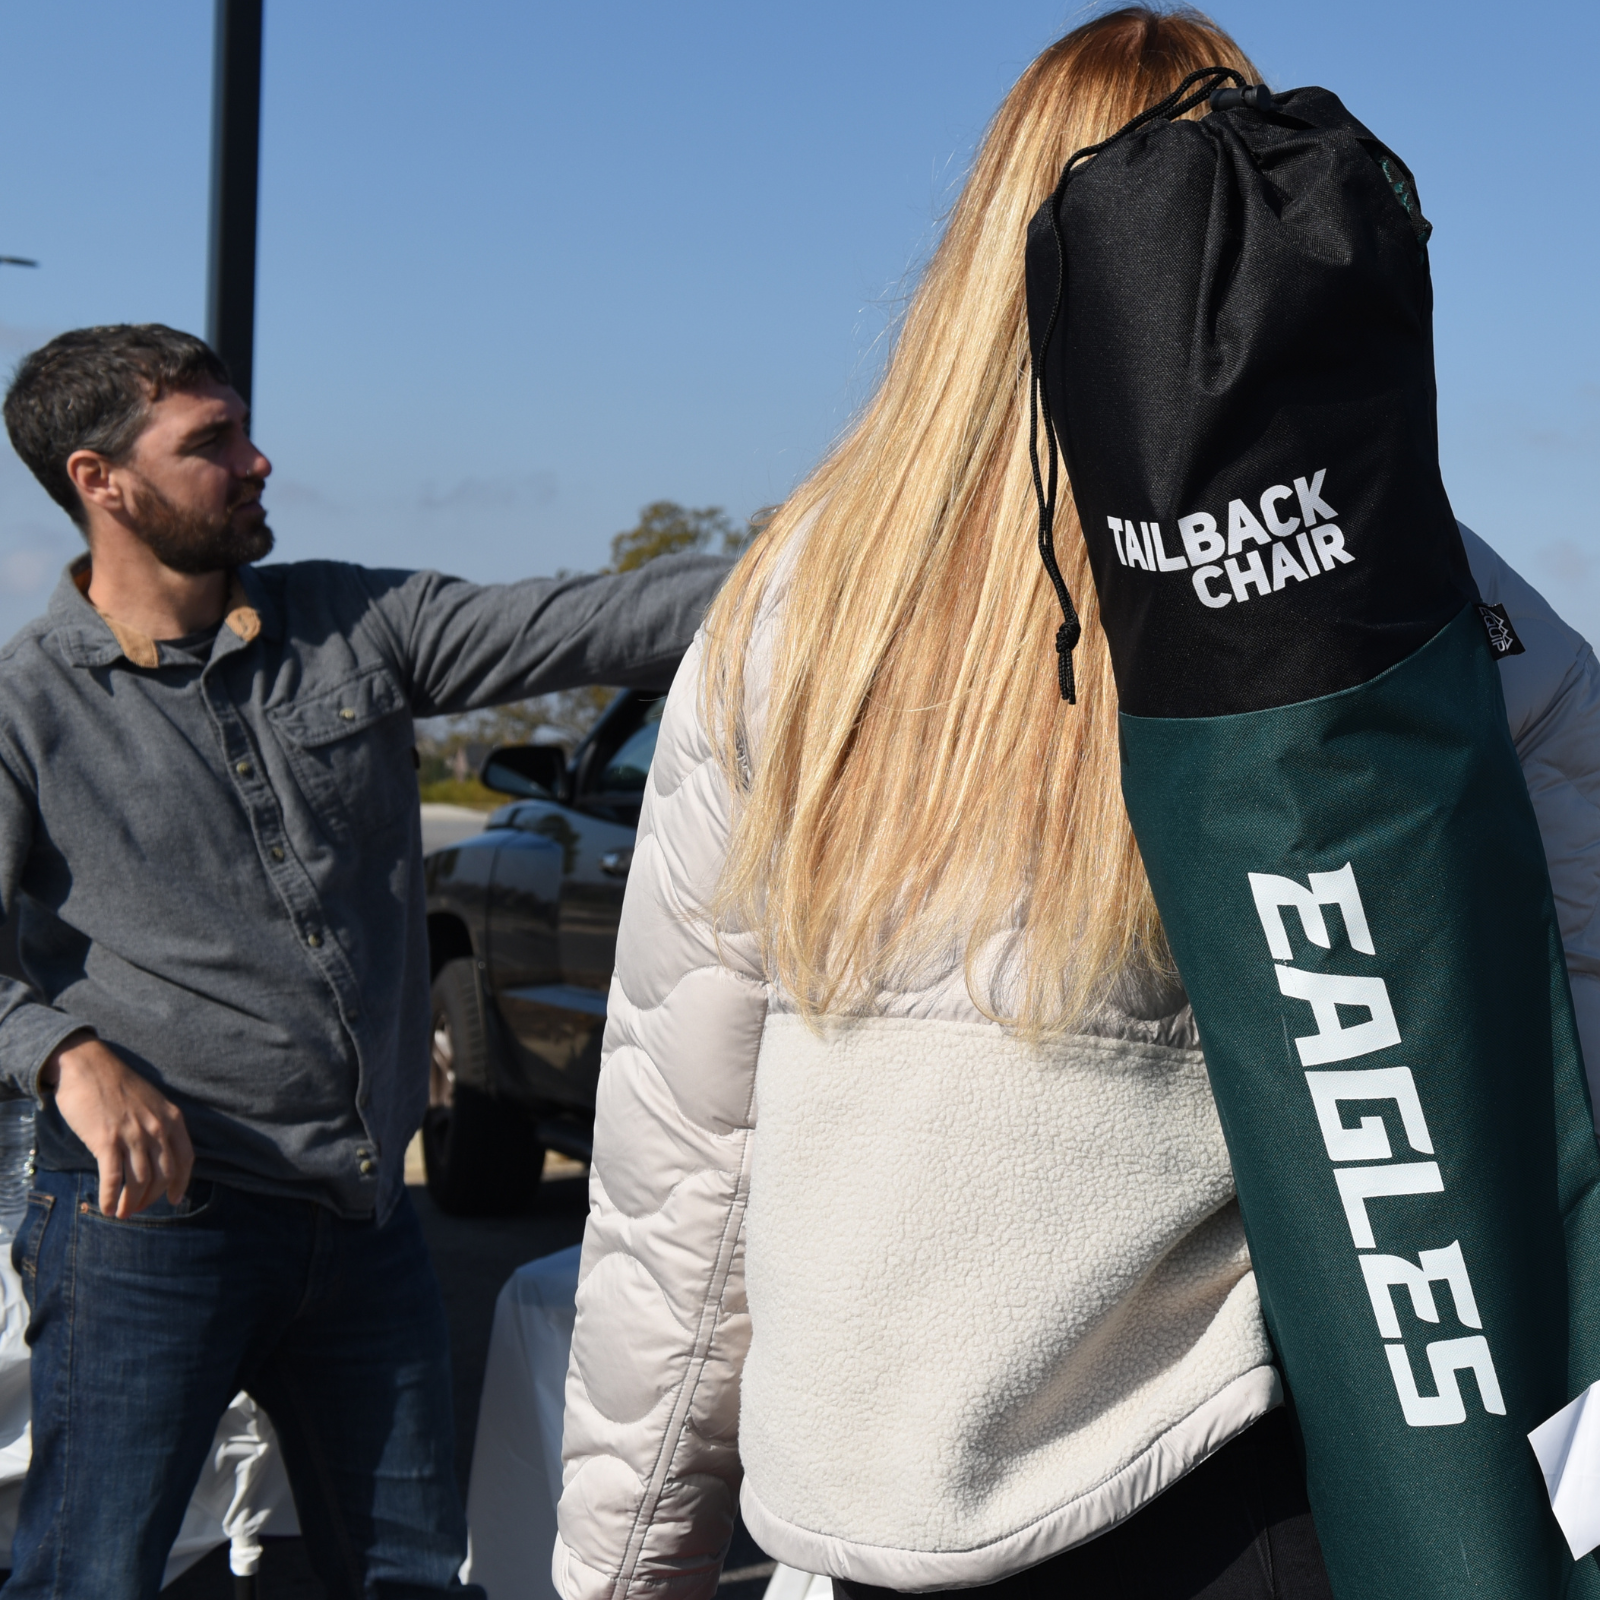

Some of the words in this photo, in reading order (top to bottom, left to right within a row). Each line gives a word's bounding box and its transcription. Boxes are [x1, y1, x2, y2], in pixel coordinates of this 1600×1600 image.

[1107, 468, 1339, 573] TAILBACK
[1191, 523, 1356, 609] CHAIR
[1478, 606, 1506, 652] EQUIP
[1247, 861, 1507, 1427] EAGLES
